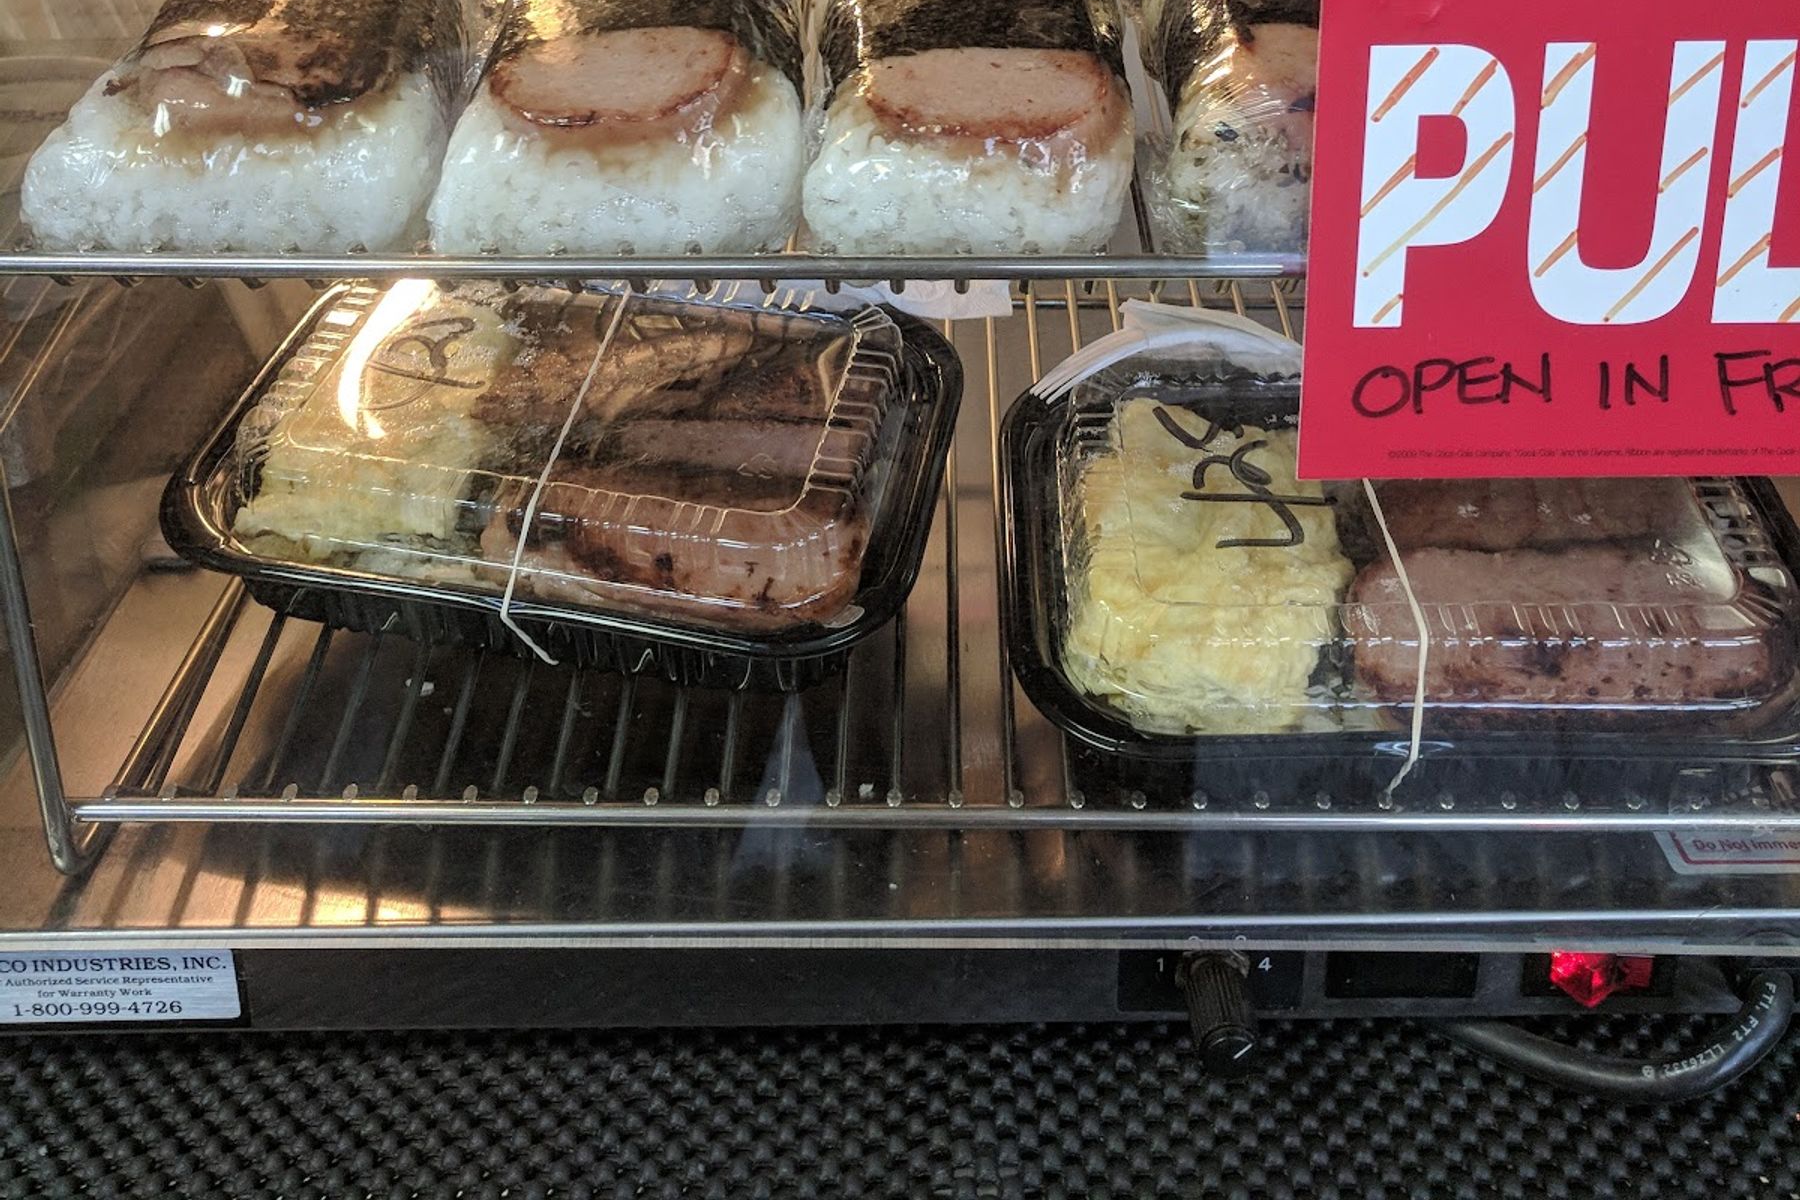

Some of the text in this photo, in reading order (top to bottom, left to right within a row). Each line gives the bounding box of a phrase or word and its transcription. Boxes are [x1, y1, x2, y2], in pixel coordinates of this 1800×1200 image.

[1351, 352, 1552, 418] OPEN
[1597, 354, 1670, 411] IN
[1692, 839, 1716, 851] Do
[33, 957, 177, 973] INDUSTRIES,
[183, 956, 226, 970] INC.
[1258, 956, 1272, 971] 4
[5, 975, 213, 987] Authorized Service Representative
[38, 987, 152, 999] for Warranty Work
[14, 1000, 183, 1017] 1-800-999-4726
